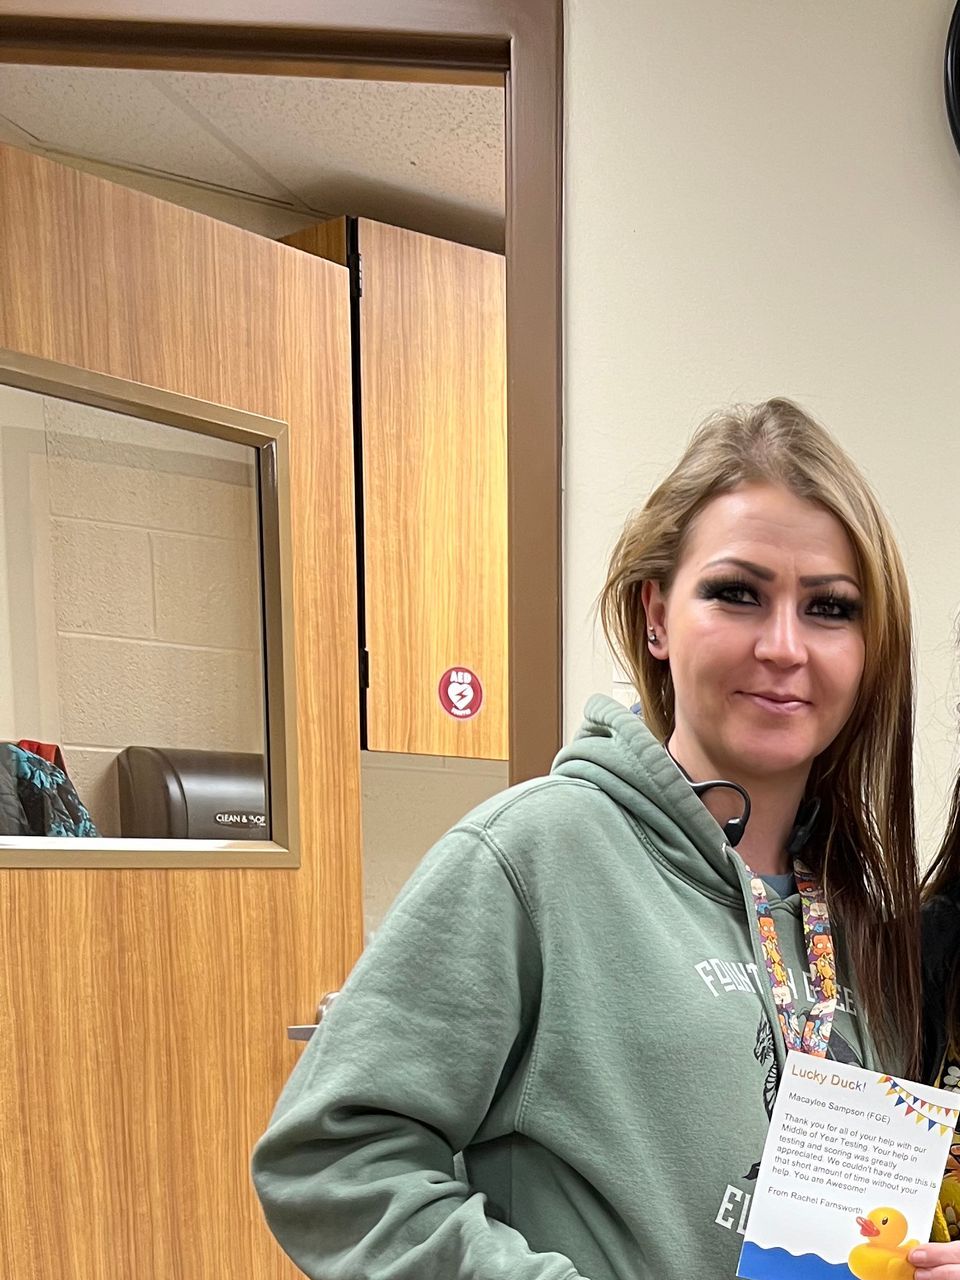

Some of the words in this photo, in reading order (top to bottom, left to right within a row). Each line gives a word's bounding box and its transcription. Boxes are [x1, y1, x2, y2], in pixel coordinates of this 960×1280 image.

[450, 670, 472, 684] AED
[216, 814, 240, 823] CLEAN
[241, 815, 248, 823] &
[791, 1064, 827, 1083] Lucky
[830, 1074, 867, 1092] Duck!
[828, 1102, 865, 1117] Sampson
[866, 1111, 891, 1125] (FGE)
[781, 1123, 808, 1137] Middle
[809, 1131, 818, 1139] of
[820, 1133, 838, 1143] Year
[840, 1138, 869, 1152] Testing.
[872, 1145, 891, 1156] Your
[892, 1150, 909, 1161] help
[910, 1154, 918, 1163] in
[785, 1113, 808, 1126] Thank
[810, 1121, 825, 1129] you
[827, 1123, 838, 1132] for
[839, 1127, 849, 1135] all
[859, 1133, 877, 1142] your
[878, 1136, 895, 1147] help
[897, 1141, 912, 1151] with
[779, 1135, 805, 1148] testing
[807, 1141, 822, 1151] and
[824, 1146, 852, 1159] scoring
[854, 1153, 869, 1163] was
[871, 1157, 897, 1170] greatly
[774, 1155, 790, 1165] that
[791, 1159, 812, 1170] short
[812, 1165, 843, 1178] amount
[853, 1175, 870, 1184] time
[872, 1179, 900, 1191] without
[900, 1186, 918, 1195] your
[776, 1146, 824, 1162] appreciated.
[826, 1156, 840, 1166] We
[841, 1161, 872, 1173] couldn't
[873, 1168, 892, 1178] have
[894, 1172, 913, 1183] done
[914, 1177, 929, 1187] this
[929, 1181, 937, 1189] is
[794, 1170, 810, 1181] You
[811, 1176, 824, 1184] are
[825, 1178, 867, 1194] Awesome!
[767, 1186, 789, 1198] From
[790, 1191, 818, 1204] Rachel
[819, 1198, 863, 1214] Farnsworth
